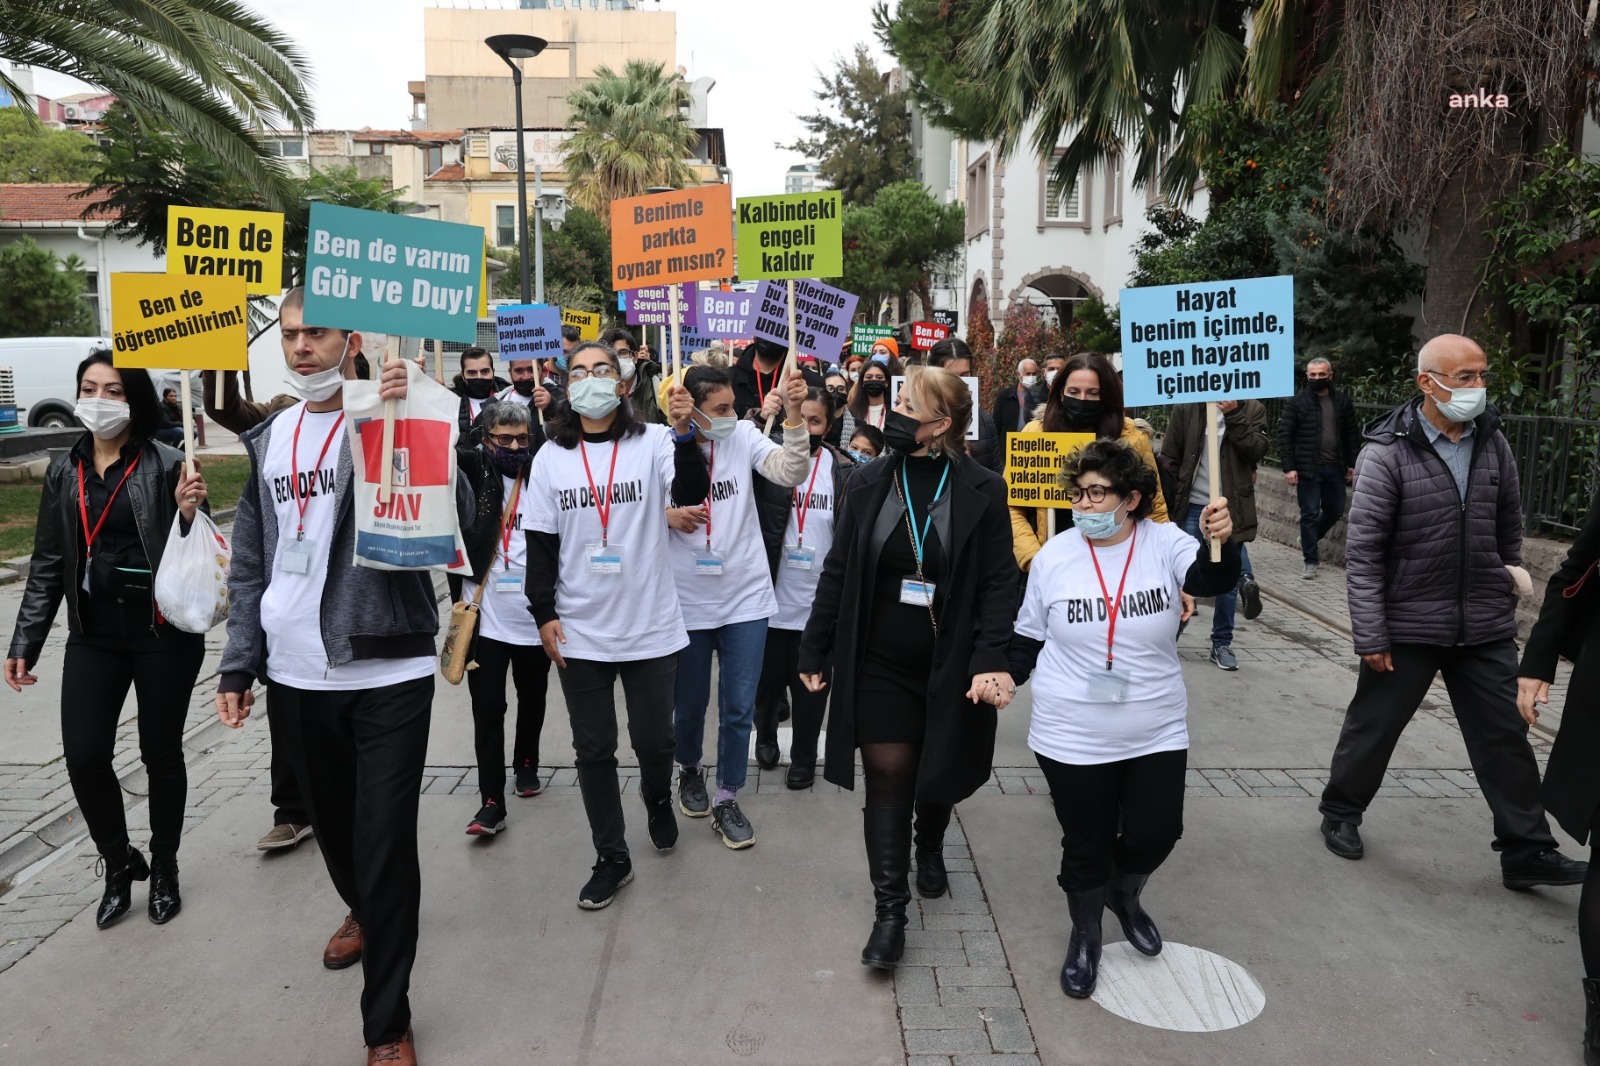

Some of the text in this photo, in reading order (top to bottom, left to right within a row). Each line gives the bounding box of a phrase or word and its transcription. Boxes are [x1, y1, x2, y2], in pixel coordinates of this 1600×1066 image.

[633, 198, 704, 225] Benimle
[740, 197, 836, 224] Kalbindeki
[176, 217, 273, 253] Ben de
[642, 226, 697, 253] parkta
[759, 225, 815, 249] engeli
[313, 229, 471, 274] Ben de varım
[617, 247, 726, 281] oynar mısın?
[761, 251, 814, 273] kaldır
[183, 254, 262, 284] varım
[138, 289, 204, 319] Ben de
[311, 266, 474, 316] Gör ve Duy!
[638, 288, 664, 300] engel
[765, 285, 834, 320] bu nyada
[1176, 287, 1236, 312] Hayat
[565, 312, 591, 325] Fırsat
[638, 312, 665, 324] engel
[704, 296, 752, 316] Ben d
[761, 299, 785, 318] Ben
[805, 316, 839, 338] varım
[114, 305, 244, 353] öğrenebilirim!
[498, 315, 524, 326] Hayatı
[915, 325, 945, 339] Ben de
[1131, 312, 1284, 343] benim içimde,
[499, 327, 545, 341] paylaşmak
[501, 339, 560, 355] için engel yok
[1147, 341, 1270, 369] ben hayatın
[1157, 369, 1261, 399] içindeyim
[1011, 437, 1059, 453] Engeller,
[1010, 453, 1050, 469] hayatın
[274, 474, 295, 504] BEN
[298, 470, 317, 499] DE
[559, 488, 577, 512] BEN
[1010, 486, 1040, 501] engel
[1067, 598, 1093, 624] BEN
